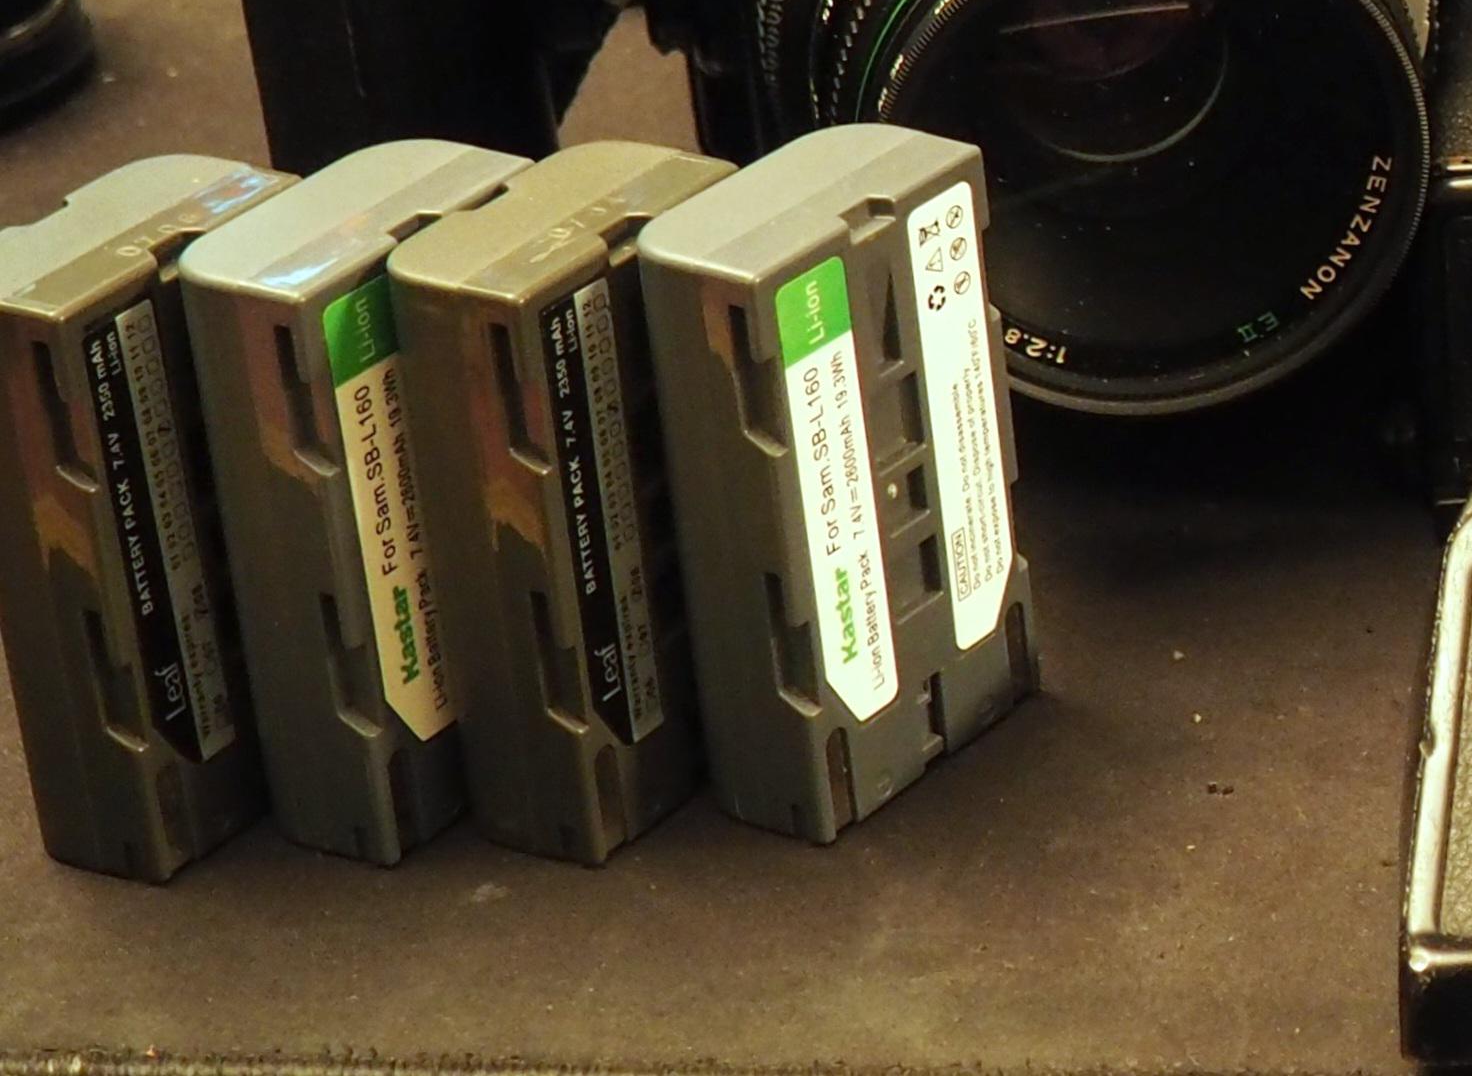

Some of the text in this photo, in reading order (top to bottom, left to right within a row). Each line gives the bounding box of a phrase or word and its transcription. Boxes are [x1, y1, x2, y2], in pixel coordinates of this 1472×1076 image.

[1299, 154, 1393, 301] ZENZANON
[355, 297, 376, 363] Li-ion
[806, 280, 825, 345] Li-ion
[1003, 326, 1071, 366] 1:2.8
[108, 432, 127, 471] 7.4V
[562, 410, 578, 448] 7.4V
[116, 477, 137, 530] PACK
[568, 455, 585, 509] PACK
[382, 538, 398, 576] For
[576, 513, 597, 596] BATTERY
[826, 518, 842, 557] For
[954, 532, 971, 597] CAUTION
[128, 534, 154, 616] BATTERY
[857, 548, 873, 591] Pack
[393, 585, 420, 685] Kastar
[835, 566, 858, 665] Kastar
[864, 588, 880, 647] Battery
[154, 660, 187, 721] Leaf
[594, 642, 622, 703] Leaf
[867, 645, 885, 691] Li-ion
